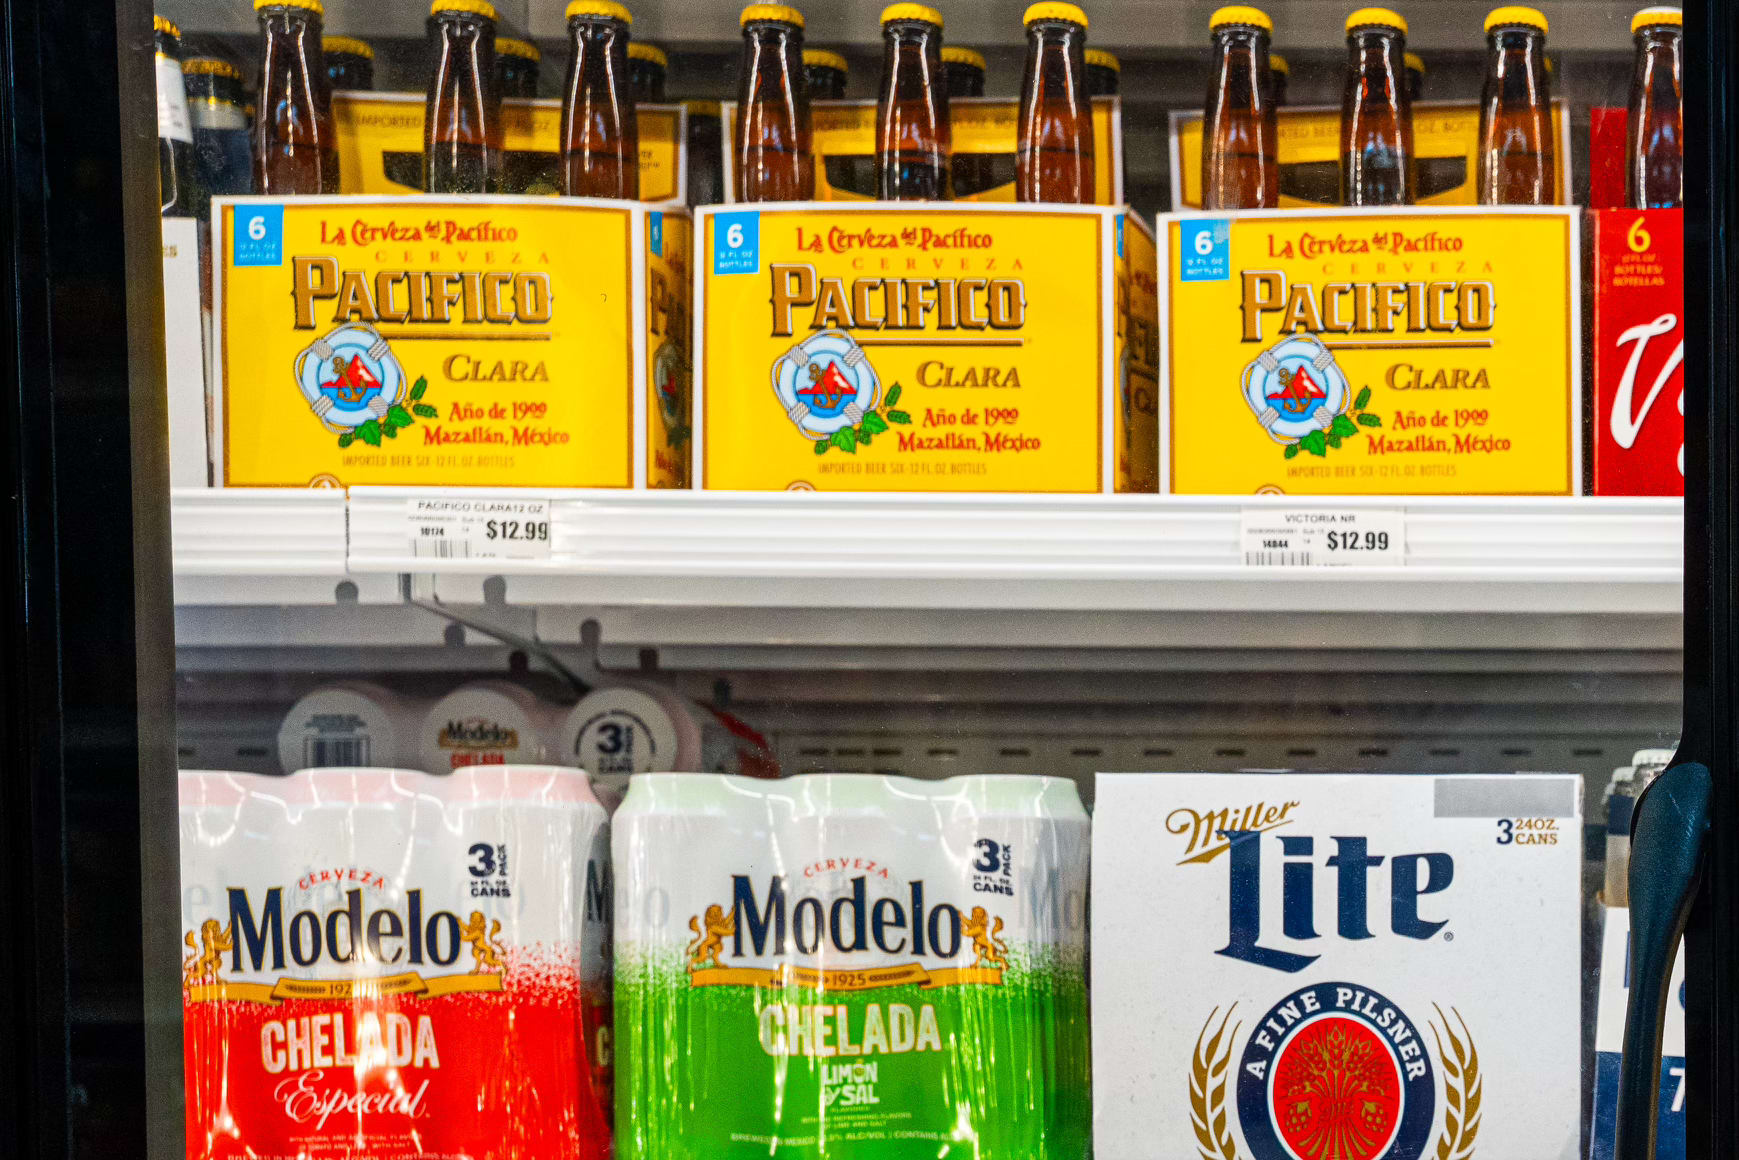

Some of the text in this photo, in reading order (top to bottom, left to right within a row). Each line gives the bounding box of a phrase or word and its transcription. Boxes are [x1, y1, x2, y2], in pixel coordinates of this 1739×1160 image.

[248, 216, 267, 240] 6
[727, 224, 744, 248] 6
[1627, 217, 1650, 252] 6
[375, 250, 550, 264] CERVEZA
[291, 256, 553, 330] PACIFICO
[770, 263, 1027, 337] PACIFICO
[1240, 269, 1496, 343] PACIFICO
[443, 355, 549, 382] CLARA
[916, 361, 1021, 388] CLARA
[450, 402, 485, 421] Año
[488, 403, 506, 419] de
[486, 520, 548, 540] $12.99
[1285, 515, 1336, 523] VICTORIA
[1328, 531, 1389, 551] $12.99
[1166, 800, 1300, 865] Miller
[1496, 818, 1513, 845] 3
[1515, 833, 1558, 845] CANS
[804, 858, 889, 879] CERVEZA
[974, 838, 1000, 872] 3
[471, 887, 510, 898] CANS
[973, 883, 1013, 896] CANS
[1214, 830, 1455, 973] Lite
[227, 885, 461, 973] Modelo
[731, 875, 961, 958] Modelo
[832, 973, 866, 987] 1925
[260, 1013, 439, 1074] CHELADA
[758, 1003, 942, 1057] CHELADA
[1245, 987, 1427, 1082] A FINE PILSNER
[275, 1070, 429, 1130] Especial
